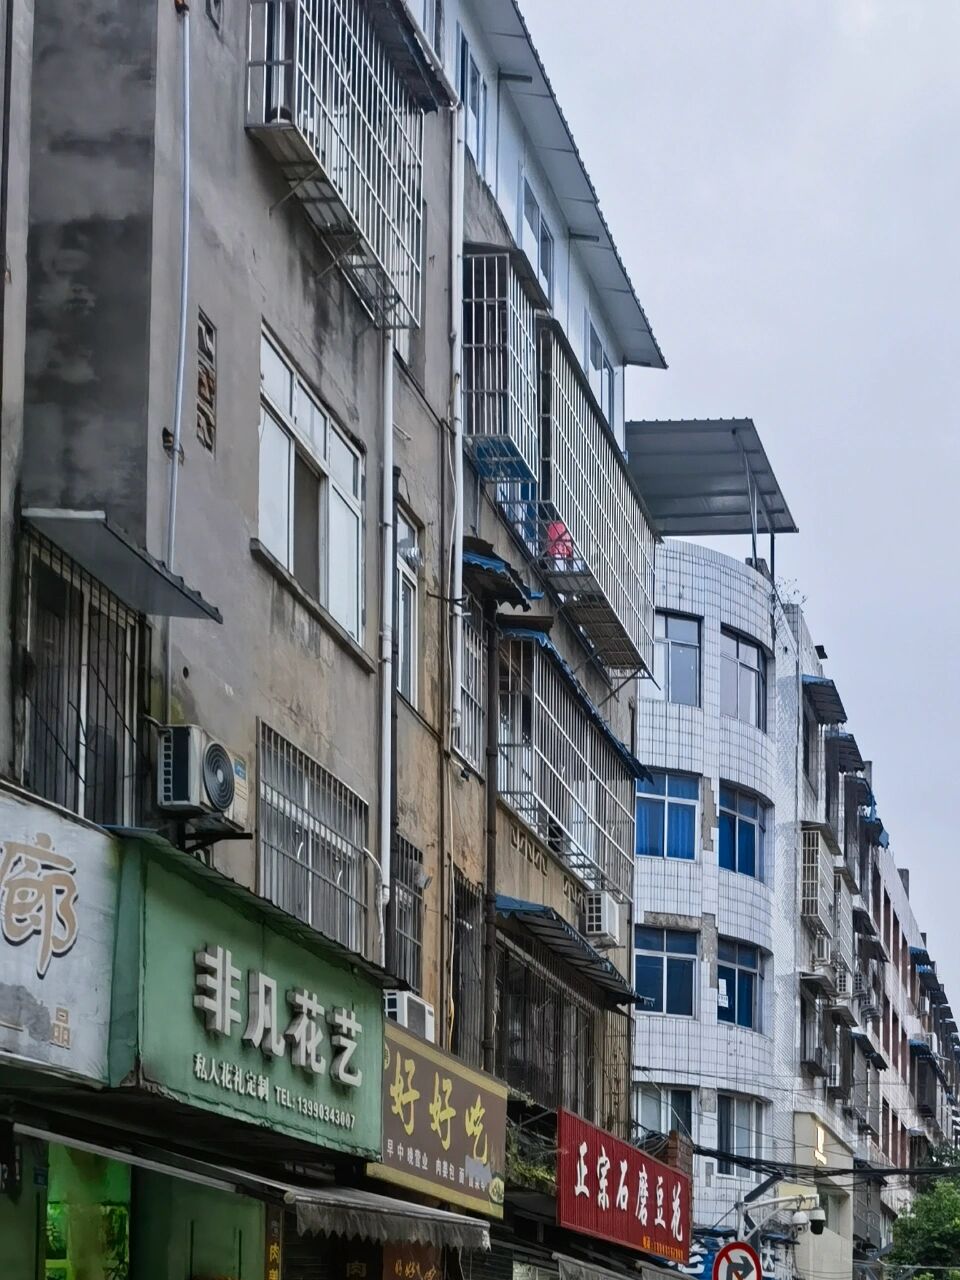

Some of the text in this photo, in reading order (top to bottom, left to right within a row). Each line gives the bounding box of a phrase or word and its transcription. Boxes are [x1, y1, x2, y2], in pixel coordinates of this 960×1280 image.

[193, 945, 363, 1088] 非凡花艺
[193, 1052, 270, 1102] 私人花礼定制
[389, 1051, 488, 1164] 好好吃
[574, 1141, 683, 1241] 正宗石磨豆花
